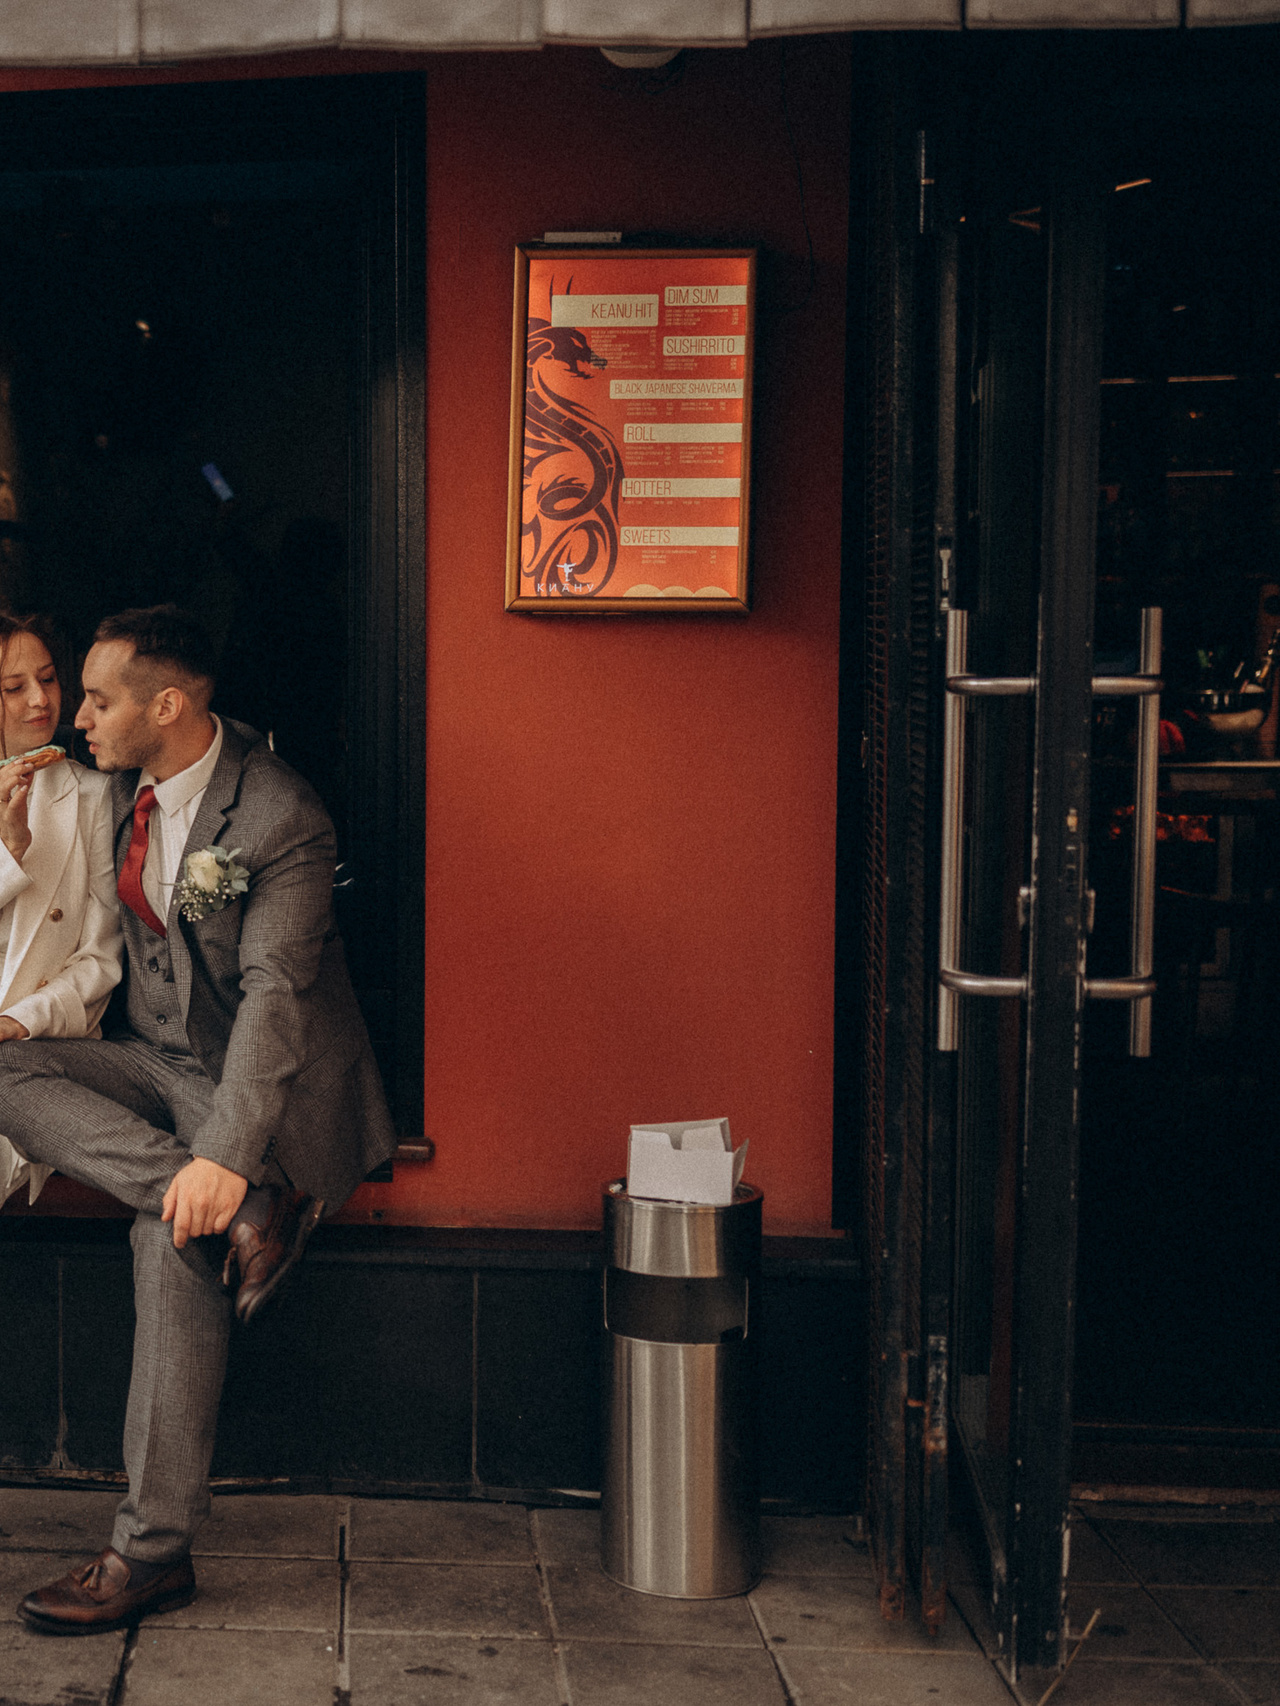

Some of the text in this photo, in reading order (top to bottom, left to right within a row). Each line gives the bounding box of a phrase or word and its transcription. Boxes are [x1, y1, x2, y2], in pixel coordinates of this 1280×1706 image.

[667, 288, 719, 304] DIM SUM
[590, 302, 633, 319] KEANU
[635, 302, 654, 318] HIT
[666, 337, 735, 354] SUSHIRRITO
[614, 382, 737, 394] BLACK JAPANESE SHAVERMA
[626, 426, 656, 441] ROLL
[624, 480, 672, 496] HOTTER
[623, 529, 671, 544] SWEETS
[537, 583, 595, 592] КИАНУ
